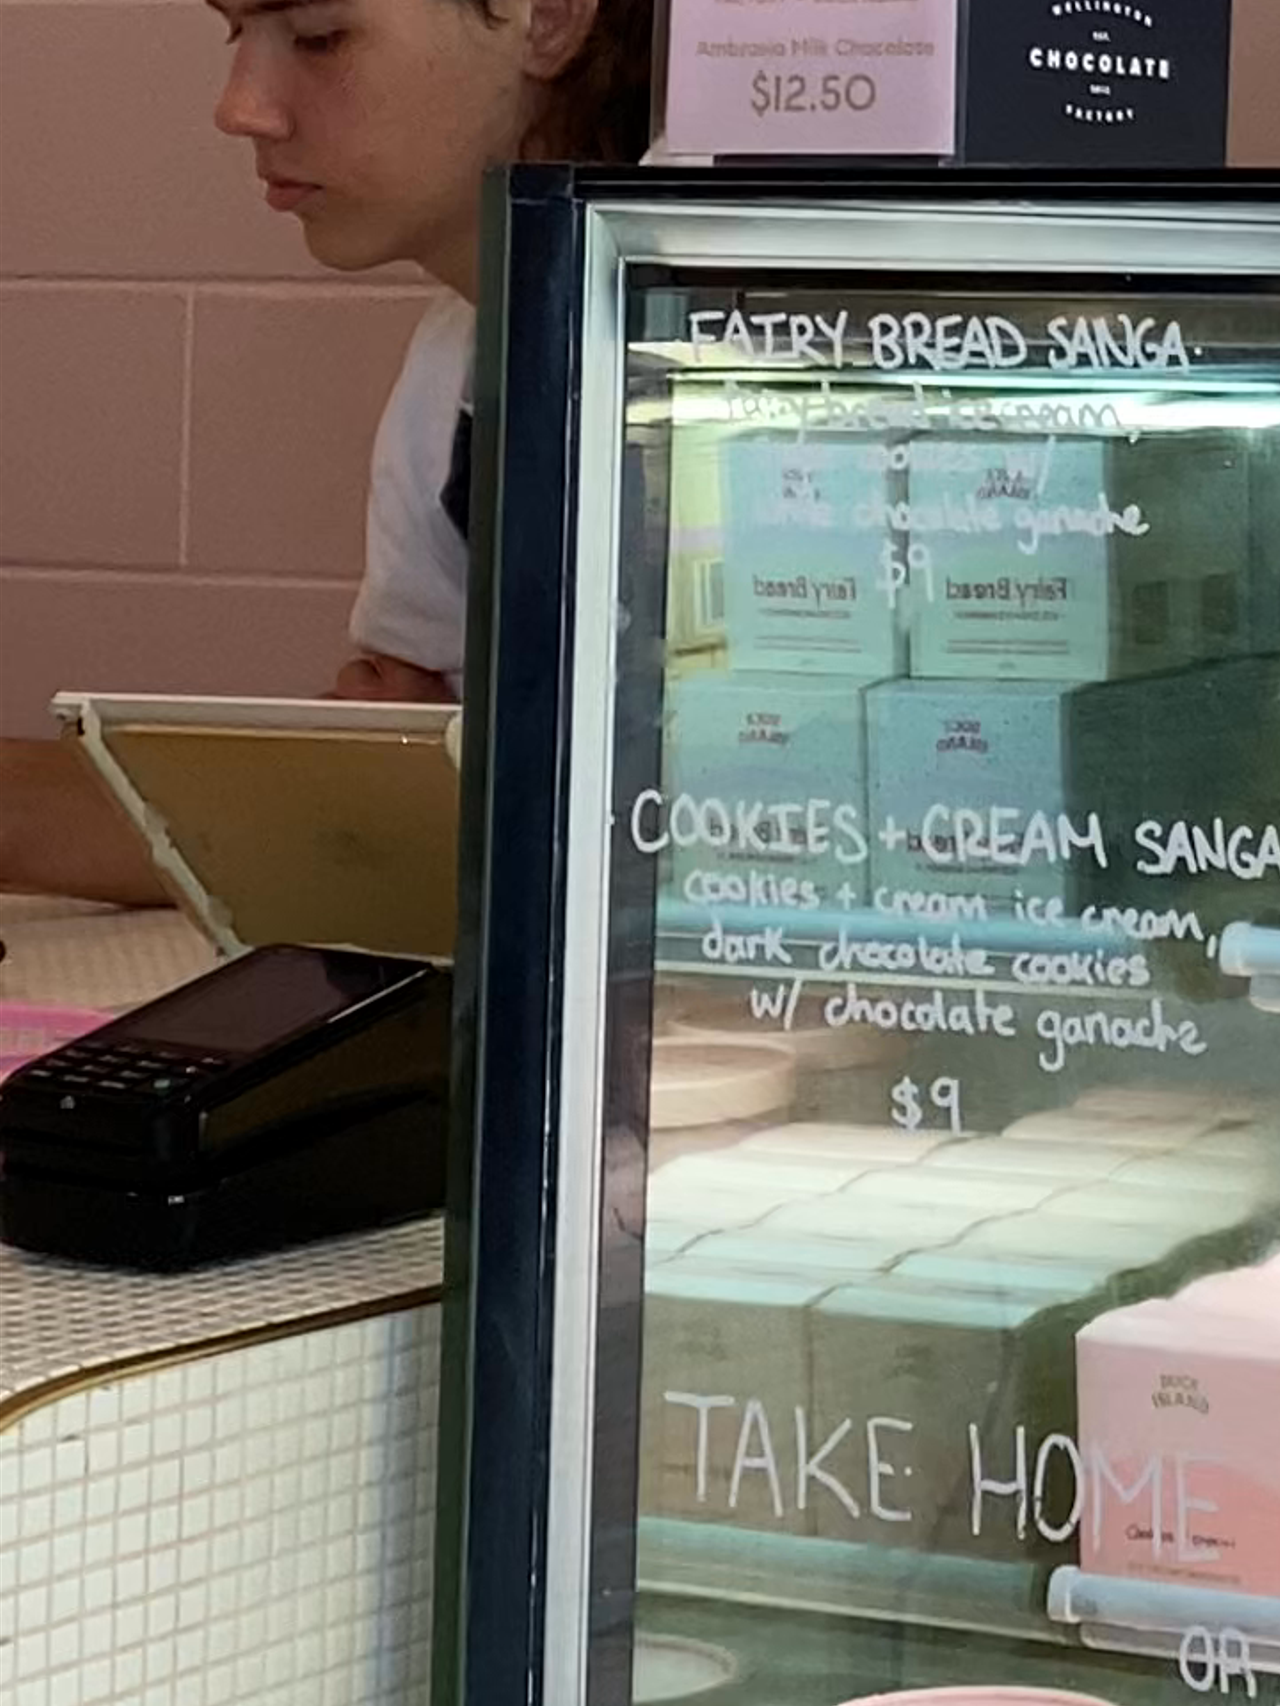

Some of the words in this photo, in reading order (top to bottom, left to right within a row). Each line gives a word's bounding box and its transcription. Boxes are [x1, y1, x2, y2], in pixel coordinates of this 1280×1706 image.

[1052, 0, 1153, 27] WELLINGTON
[697, 37, 785, 57] Ambrosia
[790, 36, 828, 56] Milk
[835, 37, 935, 57] Chocolate
[1029, 47, 1170, 79] CHOCOLATE
[750, 69, 877, 118] $12.50
[1065, 103, 1135, 123] FACTORY
[688, 309, 848, 368] FAIRY
[867, 312, 1028, 371] BREAD
[1046, 313, 1190, 374] SANGA
[630, 787, 869, 865] COOKIES
[877, 817, 909, 853] +
[920, 802, 1110, 870] CREAM
[684, 867, 821, 911] cookies
[873, 883, 989, 924] cream
[1013, 888, 1066, 927] ice
[701, 919, 793, 968] dark
[818, 932, 996, 979] chocolate
[1010, 948, 1151, 989] cookies
[823, 985, 1018, 1038] chocolate
[1038, 996, 1209, 1073] ganache
[890, 1075, 962, 1135] $9
[663, 1390, 914, 1523] TAKE
[968, 1421, 1223, 1562] HOME
[1178, 1624, 1258, 1699] OR
